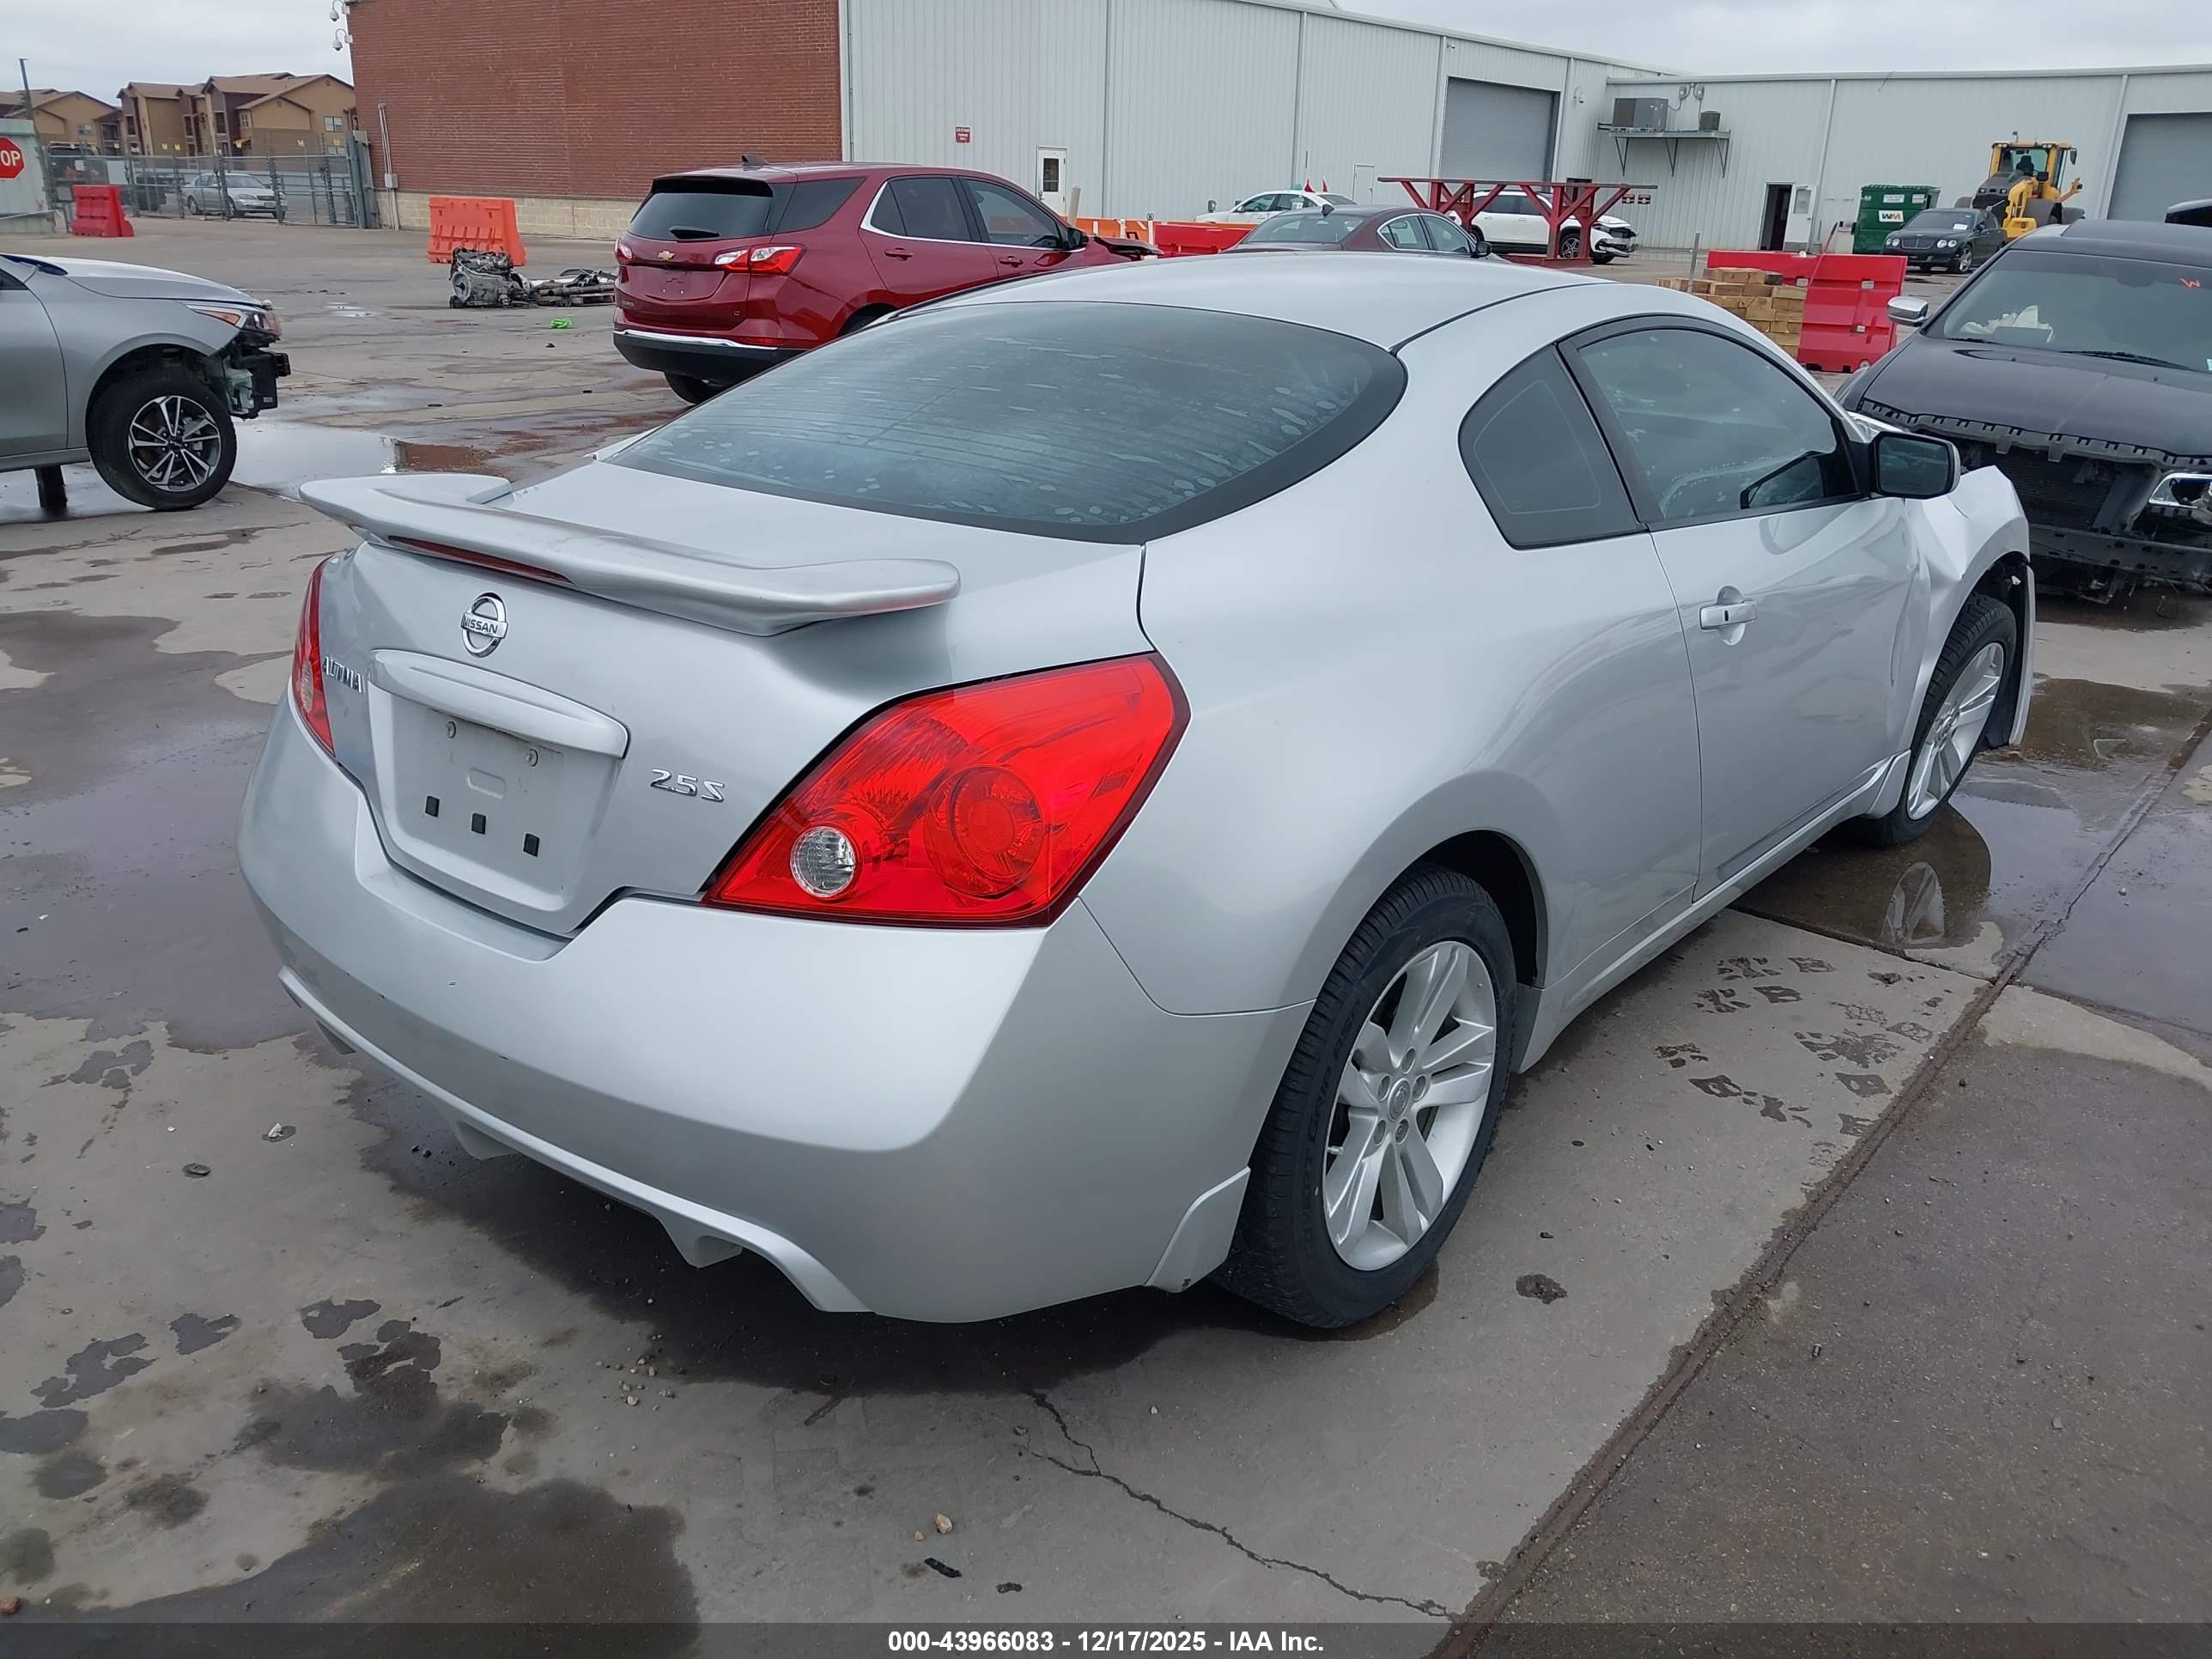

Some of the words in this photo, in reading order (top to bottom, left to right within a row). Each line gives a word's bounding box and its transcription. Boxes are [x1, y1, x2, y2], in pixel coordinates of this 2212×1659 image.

[0, 150, 21, 166] OP
[462, 613, 499, 634] NISSAN
[650, 769, 698, 796] 2.5
[702, 779, 725, 802] S
